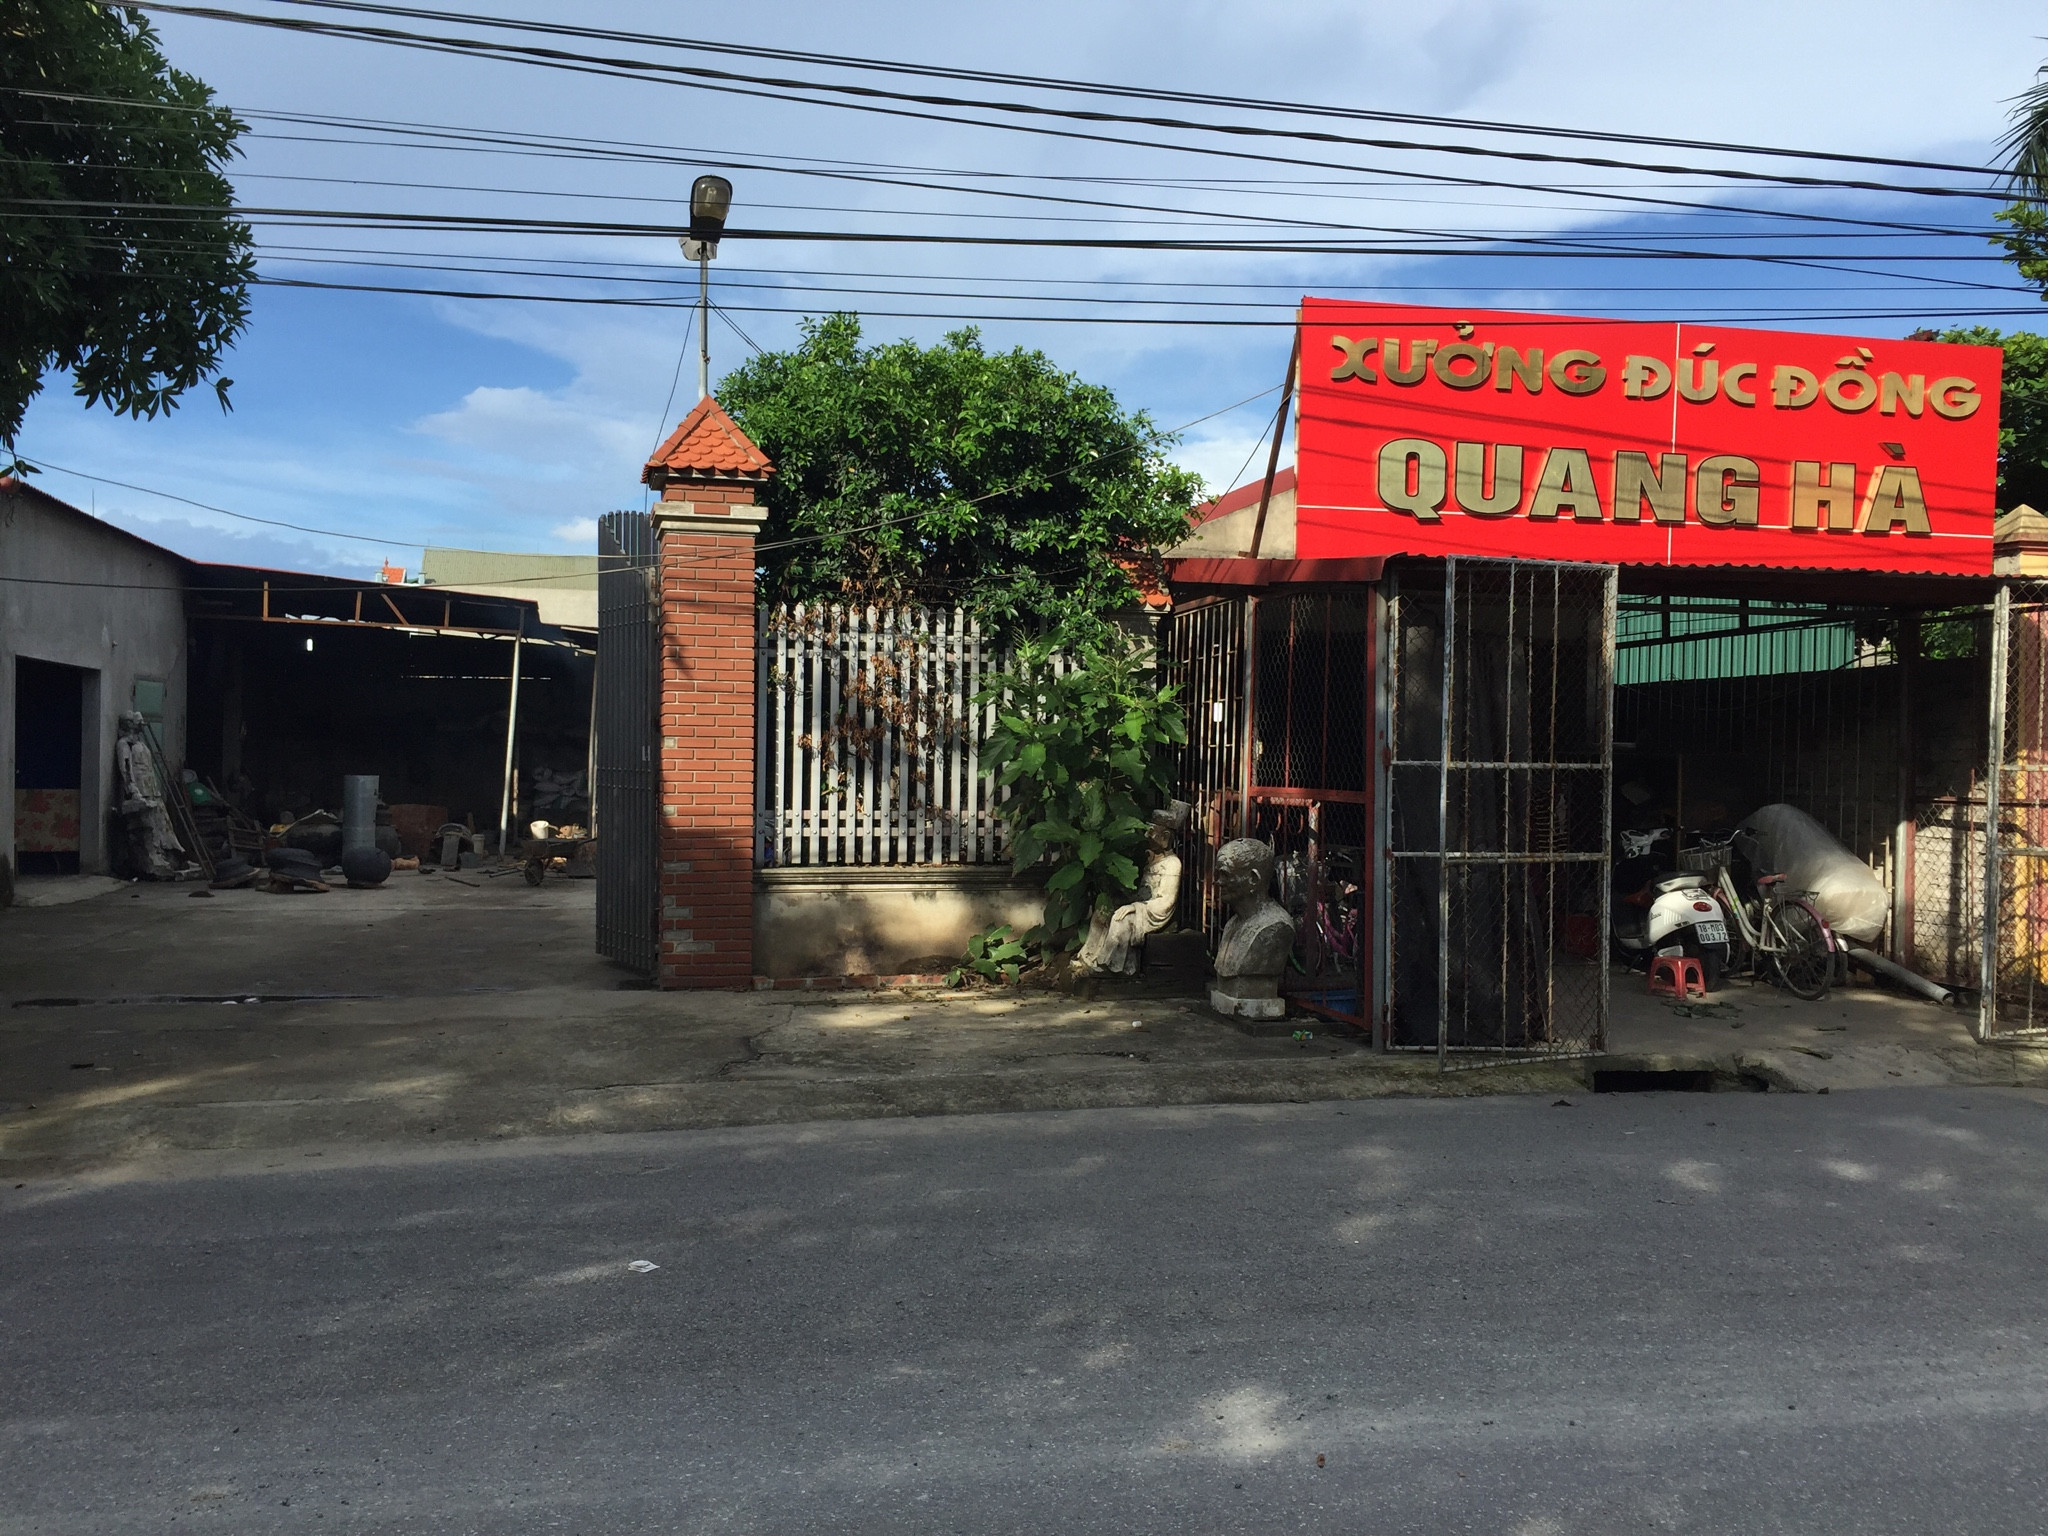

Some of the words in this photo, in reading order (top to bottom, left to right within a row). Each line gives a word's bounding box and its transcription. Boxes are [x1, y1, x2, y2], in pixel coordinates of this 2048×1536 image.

[1330, 321, 1606, 395] XƯỞNG
[1622, 342, 1757, 406] ĐÚC
[1770, 346, 1982, 421] ĐỒNG
[1376, 437, 1761, 528] QUANG
[1791, 442, 1933, 534] HÀ
